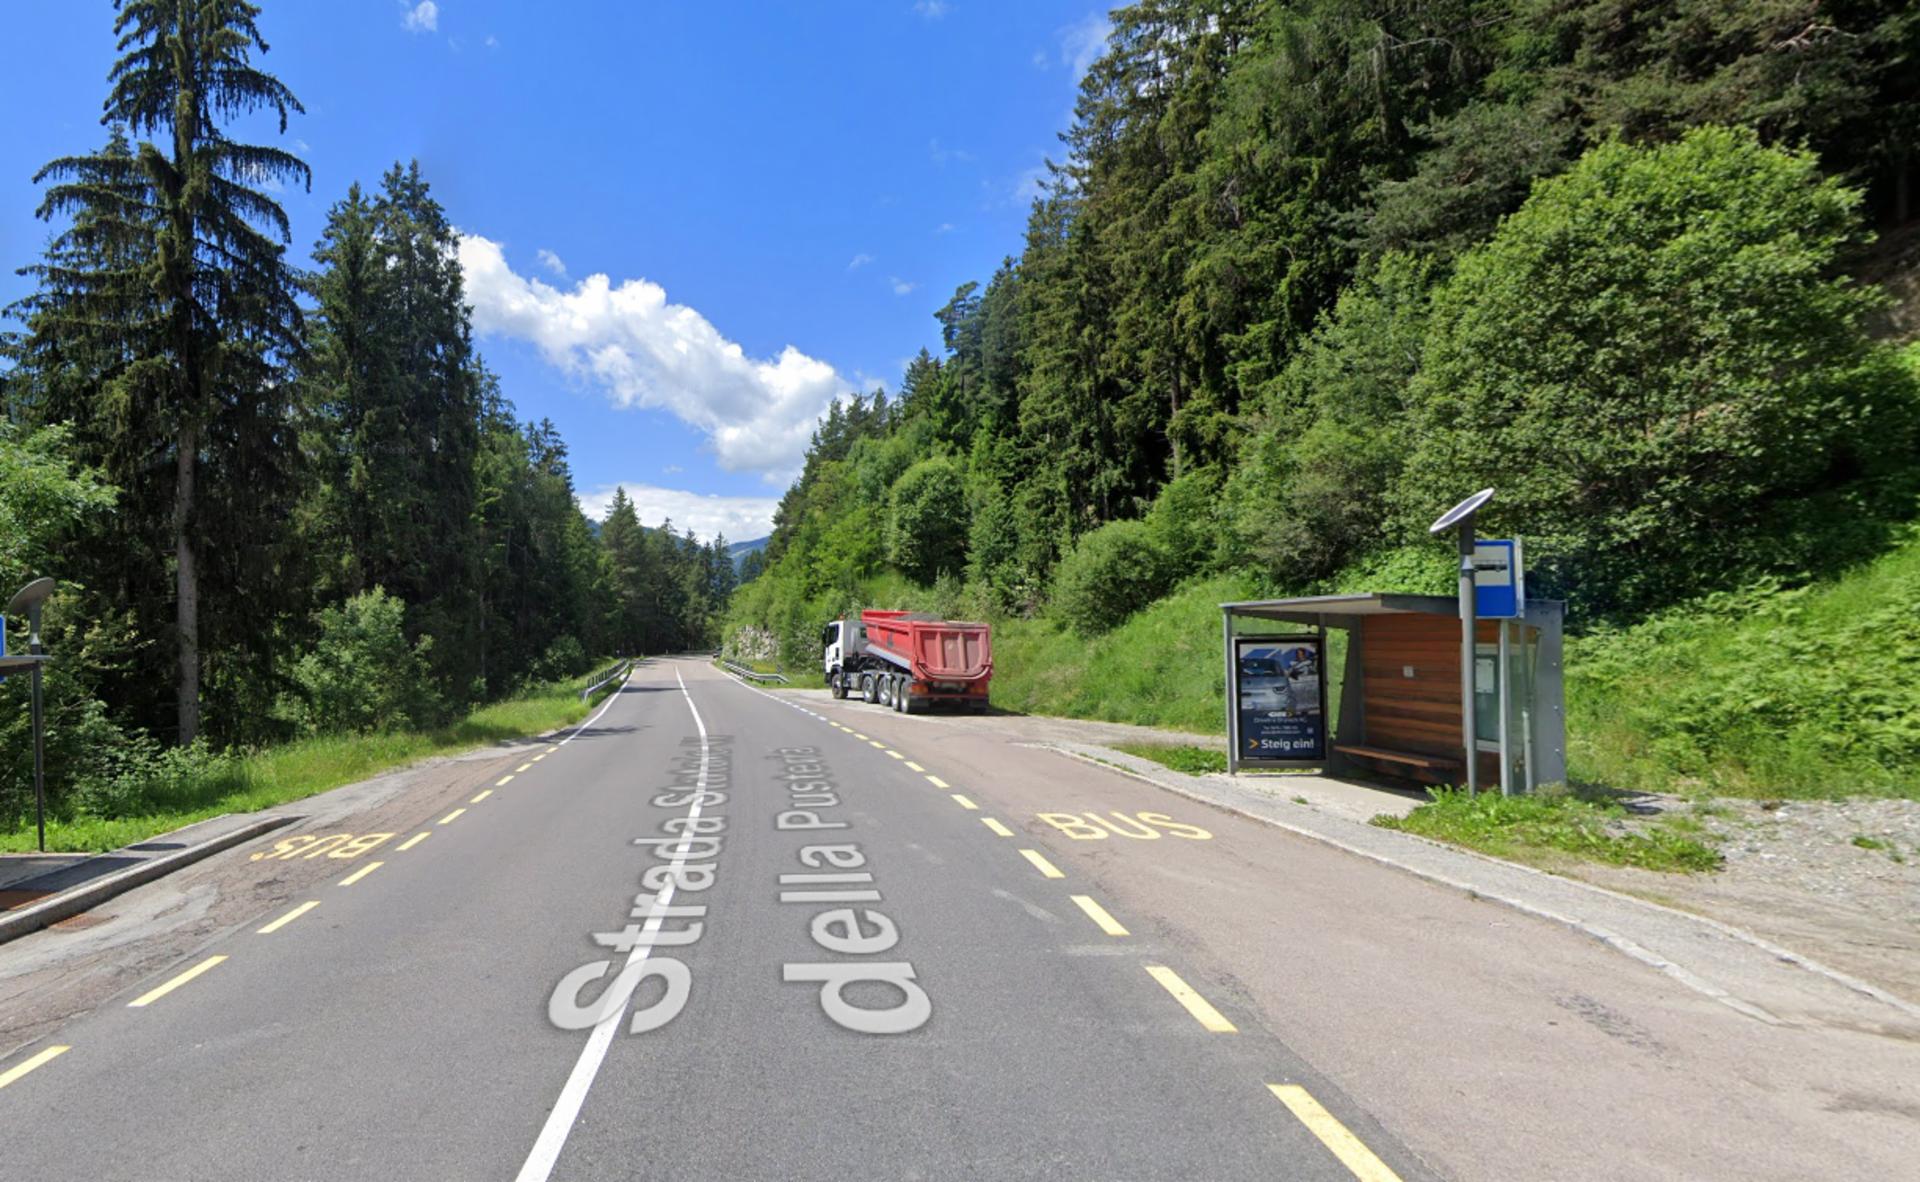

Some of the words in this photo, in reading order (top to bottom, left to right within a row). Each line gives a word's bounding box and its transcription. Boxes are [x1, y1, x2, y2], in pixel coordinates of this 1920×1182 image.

[1261, 738, 1291, 751] Steig
[1293, 738, 1314, 749] ein!
[1036, 811, 1213, 841] BUS
[250, 832, 396, 861] BUS
